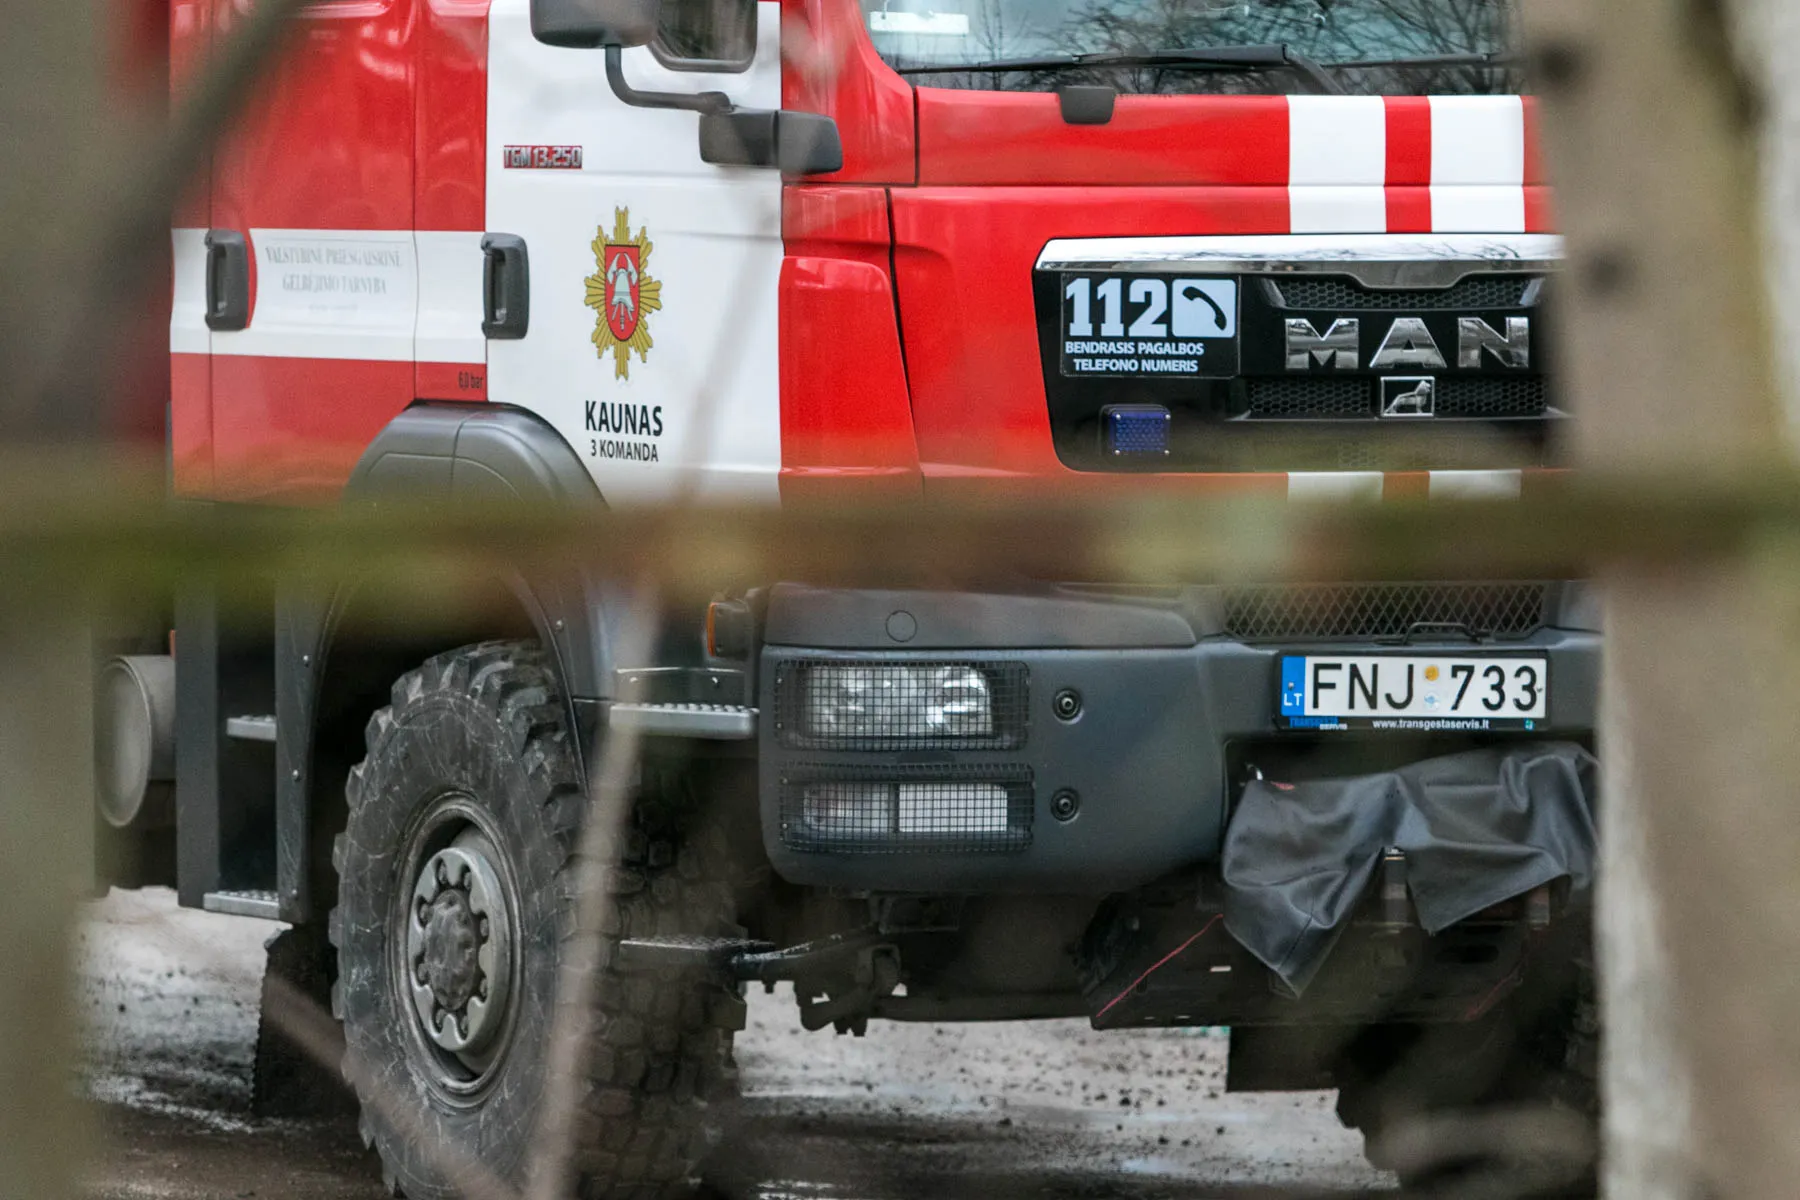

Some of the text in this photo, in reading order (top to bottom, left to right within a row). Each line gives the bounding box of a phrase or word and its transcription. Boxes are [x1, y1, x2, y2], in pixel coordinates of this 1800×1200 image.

[504, 147, 582, 167] TGM 13.250
[1066, 278, 1167, 337] 112
[1065, 341, 1204, 356] BENDRASIS PAGALBOS
[1285, 317, 1529, 369] MAN
[1073, 359, 1198, 372] TELEFONO NUMERIS
[585, 400, 663, 437] KAUNAS
[590, 439, 659, 462] 3 KOMANDA
[1312, 663, 1537, 711] FNJ 733
[1284, 693, 1303, 706] LT
[1372, 719, 1490, 731] www.transgestaservis.lt
